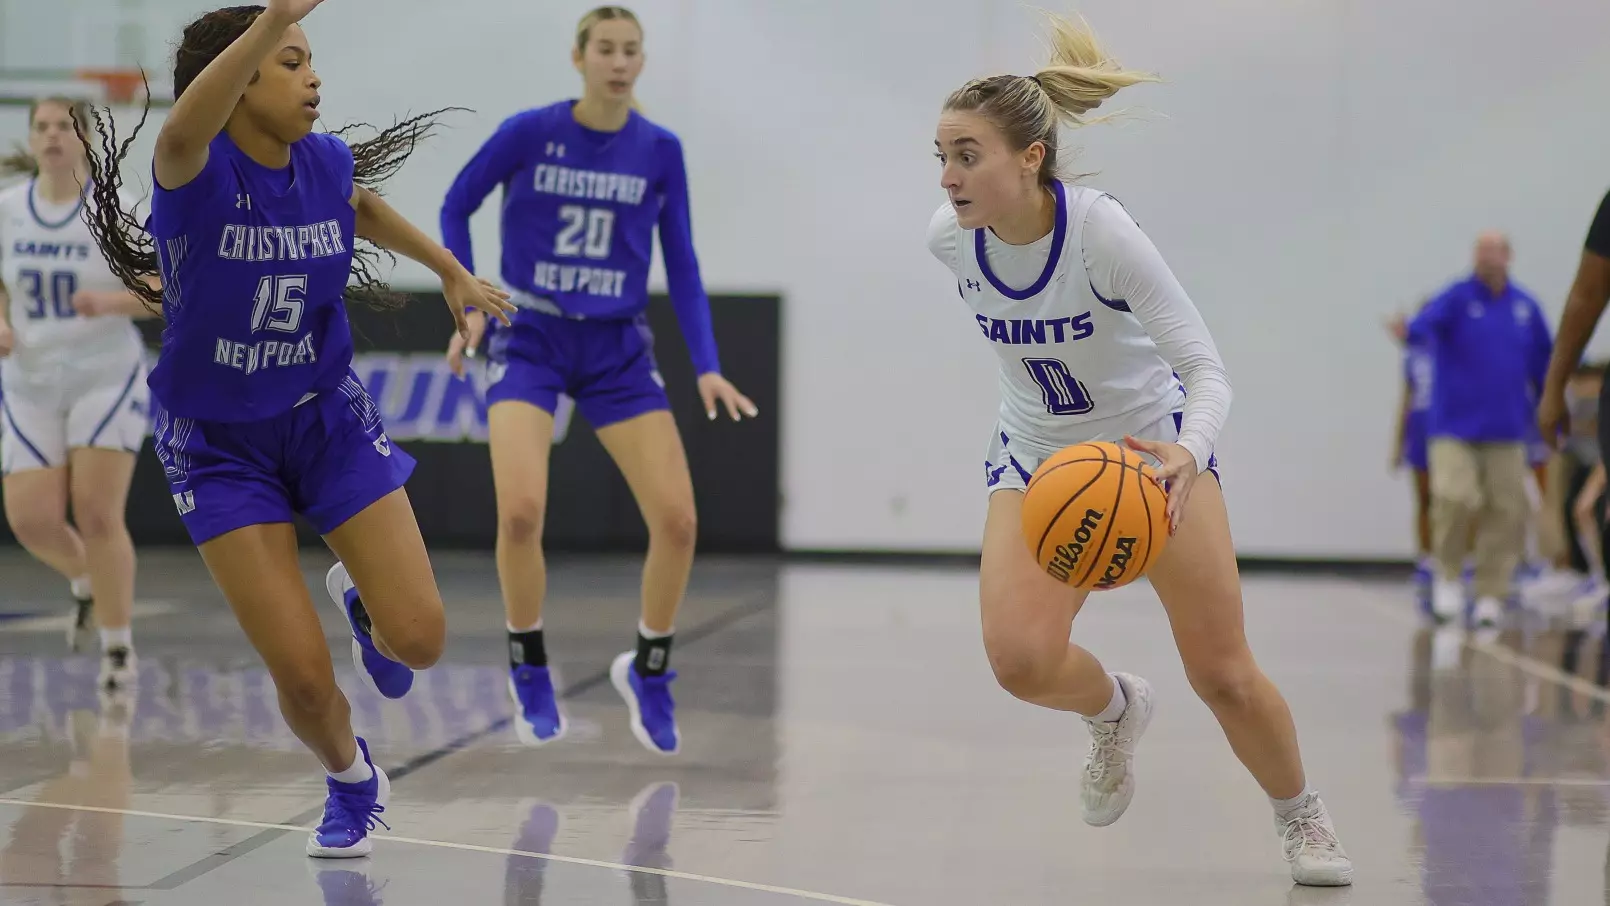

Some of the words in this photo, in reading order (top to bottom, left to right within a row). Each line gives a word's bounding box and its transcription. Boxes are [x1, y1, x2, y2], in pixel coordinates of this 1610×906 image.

[14, 242, 88, 259] SAINTS
[218, 219, 346, 261] CHRISTOPHER
[554, 205, 615, 259] 20
[18, 269, 77, 319] 30
[534, 261, 626, 297] NEWPORT
[251, 274, 308, 334] 15
[975, 311, 1095, 345] SAINTS
[214, 331, 317, 375] NEWPORT
[1046, 508, 1104, 583] Wilson
[1093, 537, 1137, 587] NCAA
